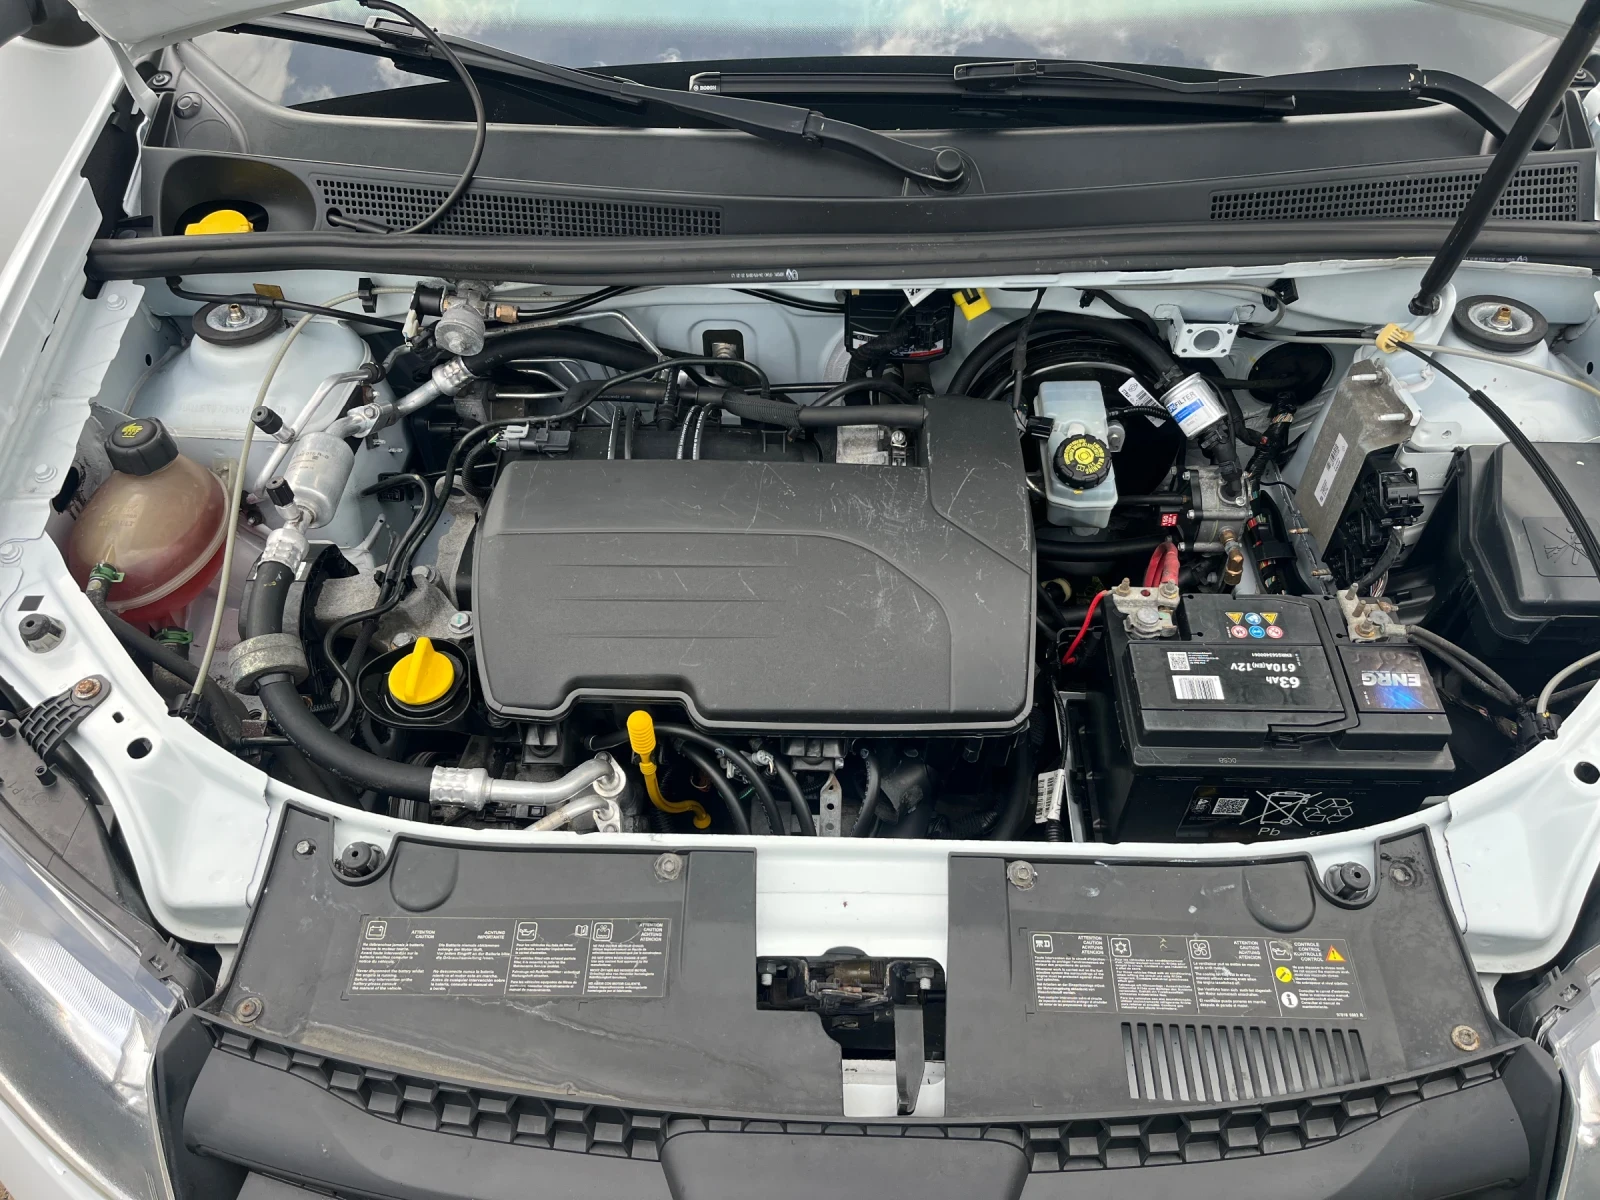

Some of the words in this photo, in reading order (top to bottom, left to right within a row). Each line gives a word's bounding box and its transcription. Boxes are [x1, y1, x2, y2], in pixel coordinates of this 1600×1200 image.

[1175, 391, 1196, 407] FILTER
[1265, 675, 1300, 689] 63Ah
[1361, 672, 1422, 687] ENRG
[1257, 827, 1281, 836] Pb
